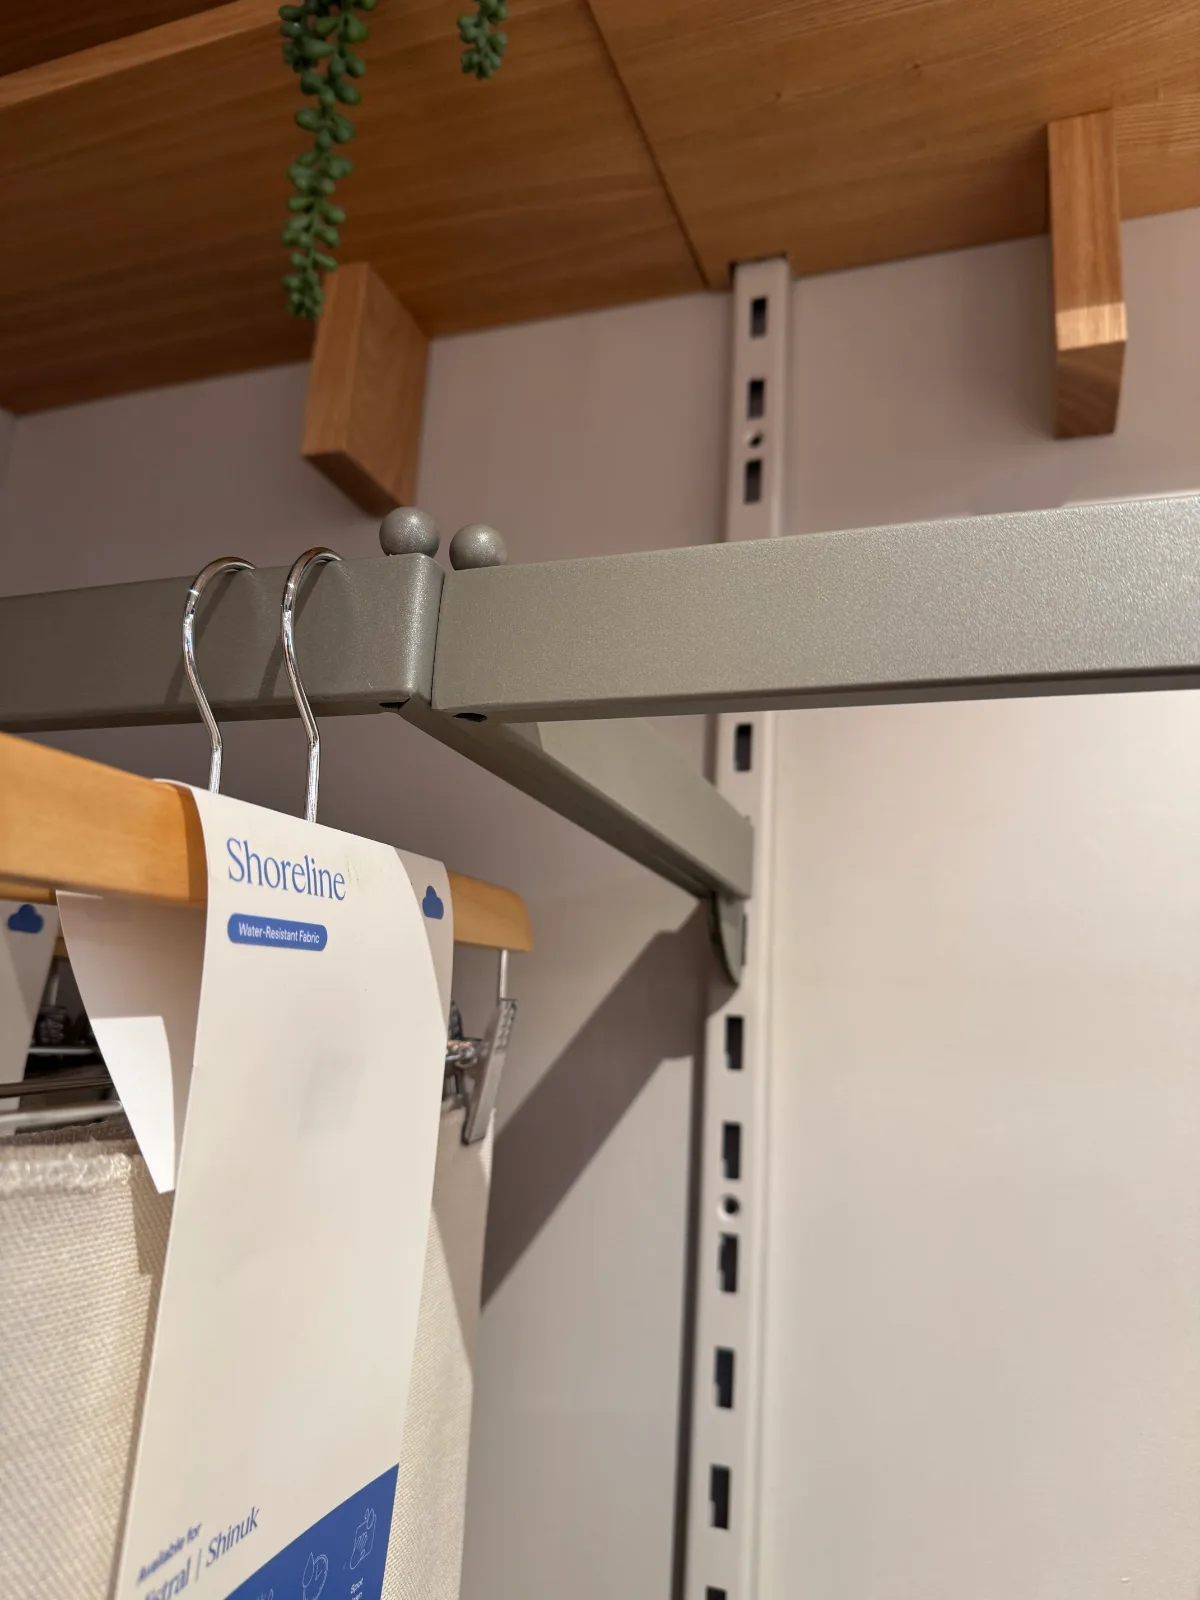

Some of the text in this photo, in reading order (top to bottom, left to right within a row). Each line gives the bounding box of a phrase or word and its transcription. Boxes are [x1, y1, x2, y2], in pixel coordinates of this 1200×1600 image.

[226, 837, 346, 901] Shoreline
[238, 922, 320, 944] Water-Resistant Fabric
[186, 1522, 202, 1544] for
[205, 1505, 260, 1568] Shinuk
